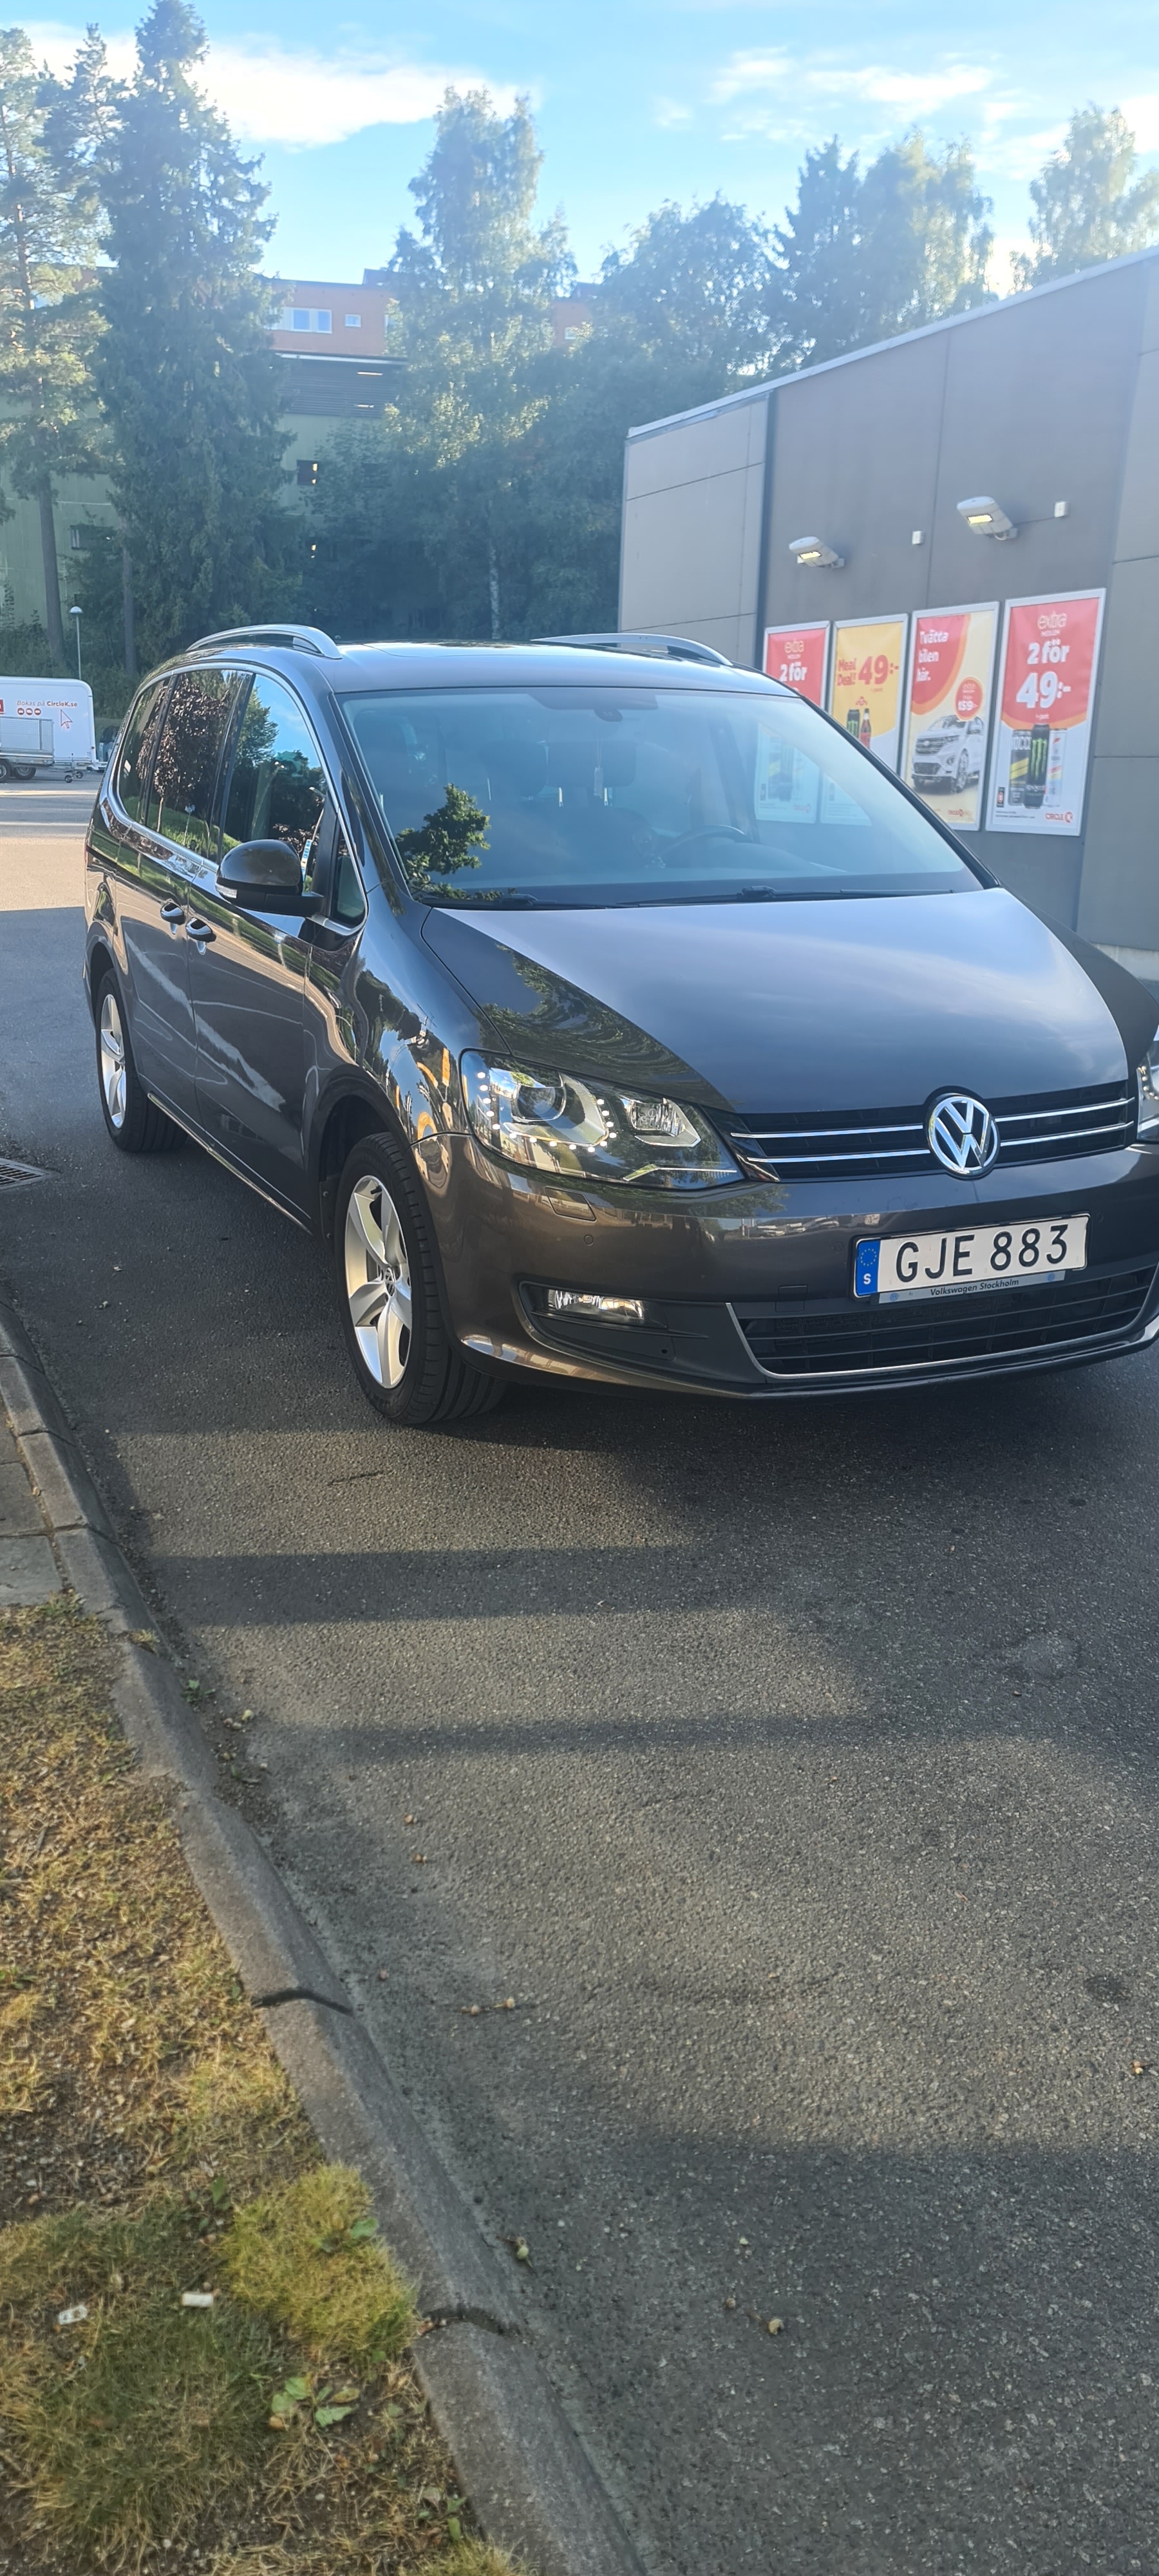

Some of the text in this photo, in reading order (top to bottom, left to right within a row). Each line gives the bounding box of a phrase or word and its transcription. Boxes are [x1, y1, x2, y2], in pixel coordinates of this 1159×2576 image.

[1027, 639, 1070, 665] 2 för
[780, 661, 807, 681] 2 för
[838, 655, 899, 685] Meal 49:-
[1016, 671, 1071, 708] 49:-
[896, 1224, 1069, 1283] GJE 883
[863, 1273, 872, 1285] S
[930, 1279, 1019, 1296] Volkswagen Stockholm
